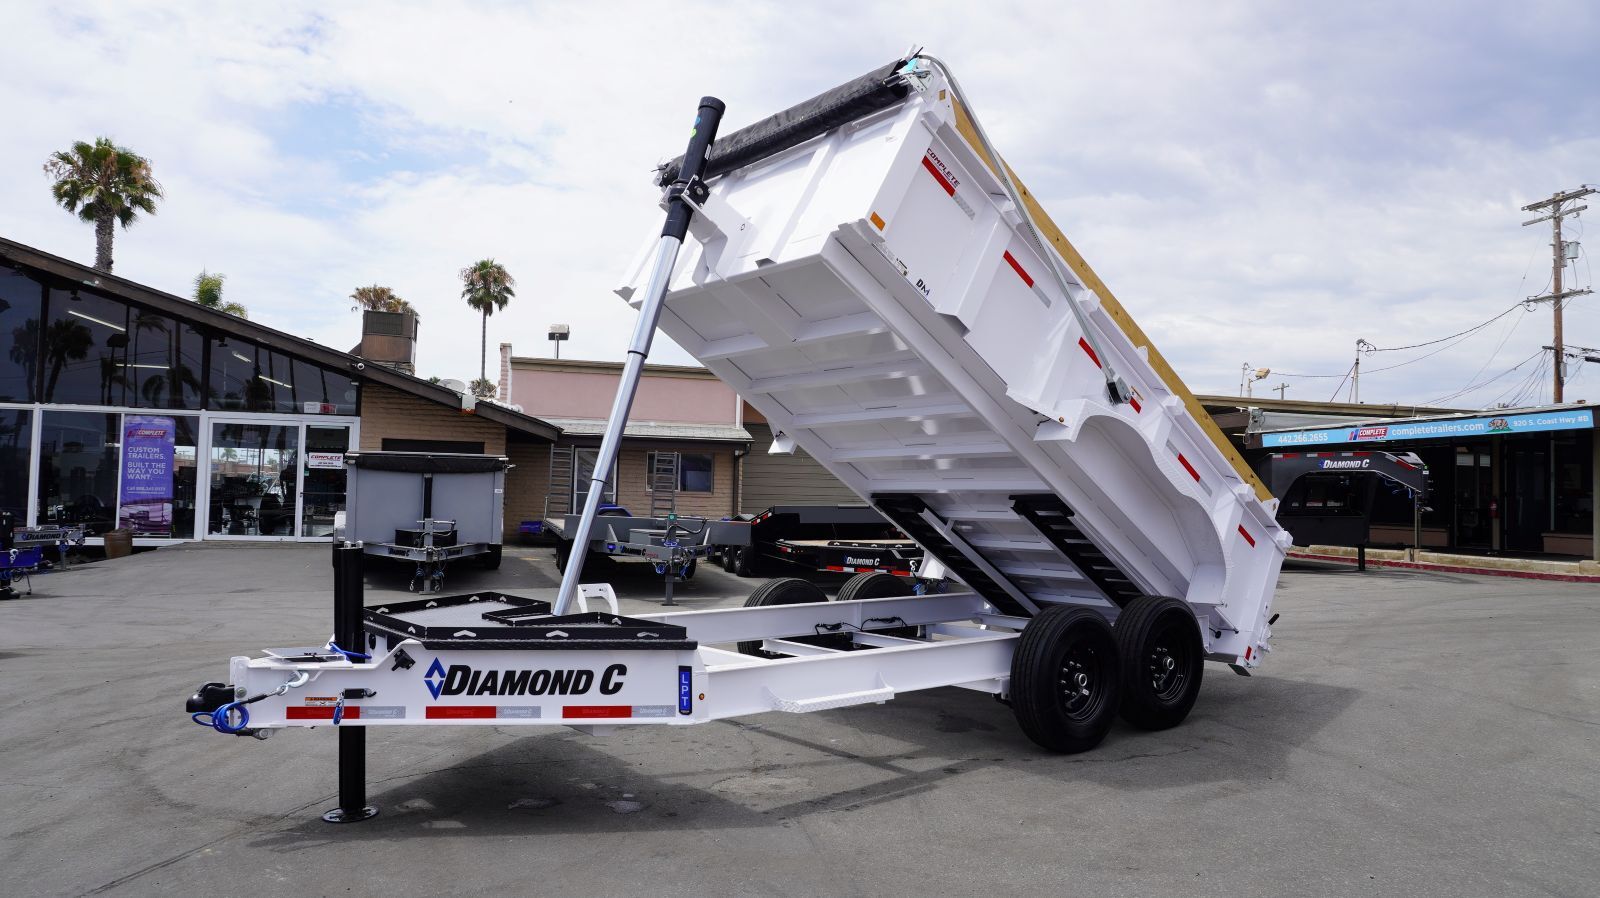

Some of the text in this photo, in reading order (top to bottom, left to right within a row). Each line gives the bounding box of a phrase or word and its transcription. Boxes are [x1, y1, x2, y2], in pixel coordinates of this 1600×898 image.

[926, 147, 961, 187] COMPLETE
[1359, 428, 1386, 436] COMPLETE
[1391, 423, 1485, 436] completetrailers.com
[127, 452, 166, 460] TRAILERS.
[1322, 459, 1370, 469] DIAMOND C
[846, 556, 880, 566] DIAMOND C
[441, 663, 628, 696] DIAMOND C
